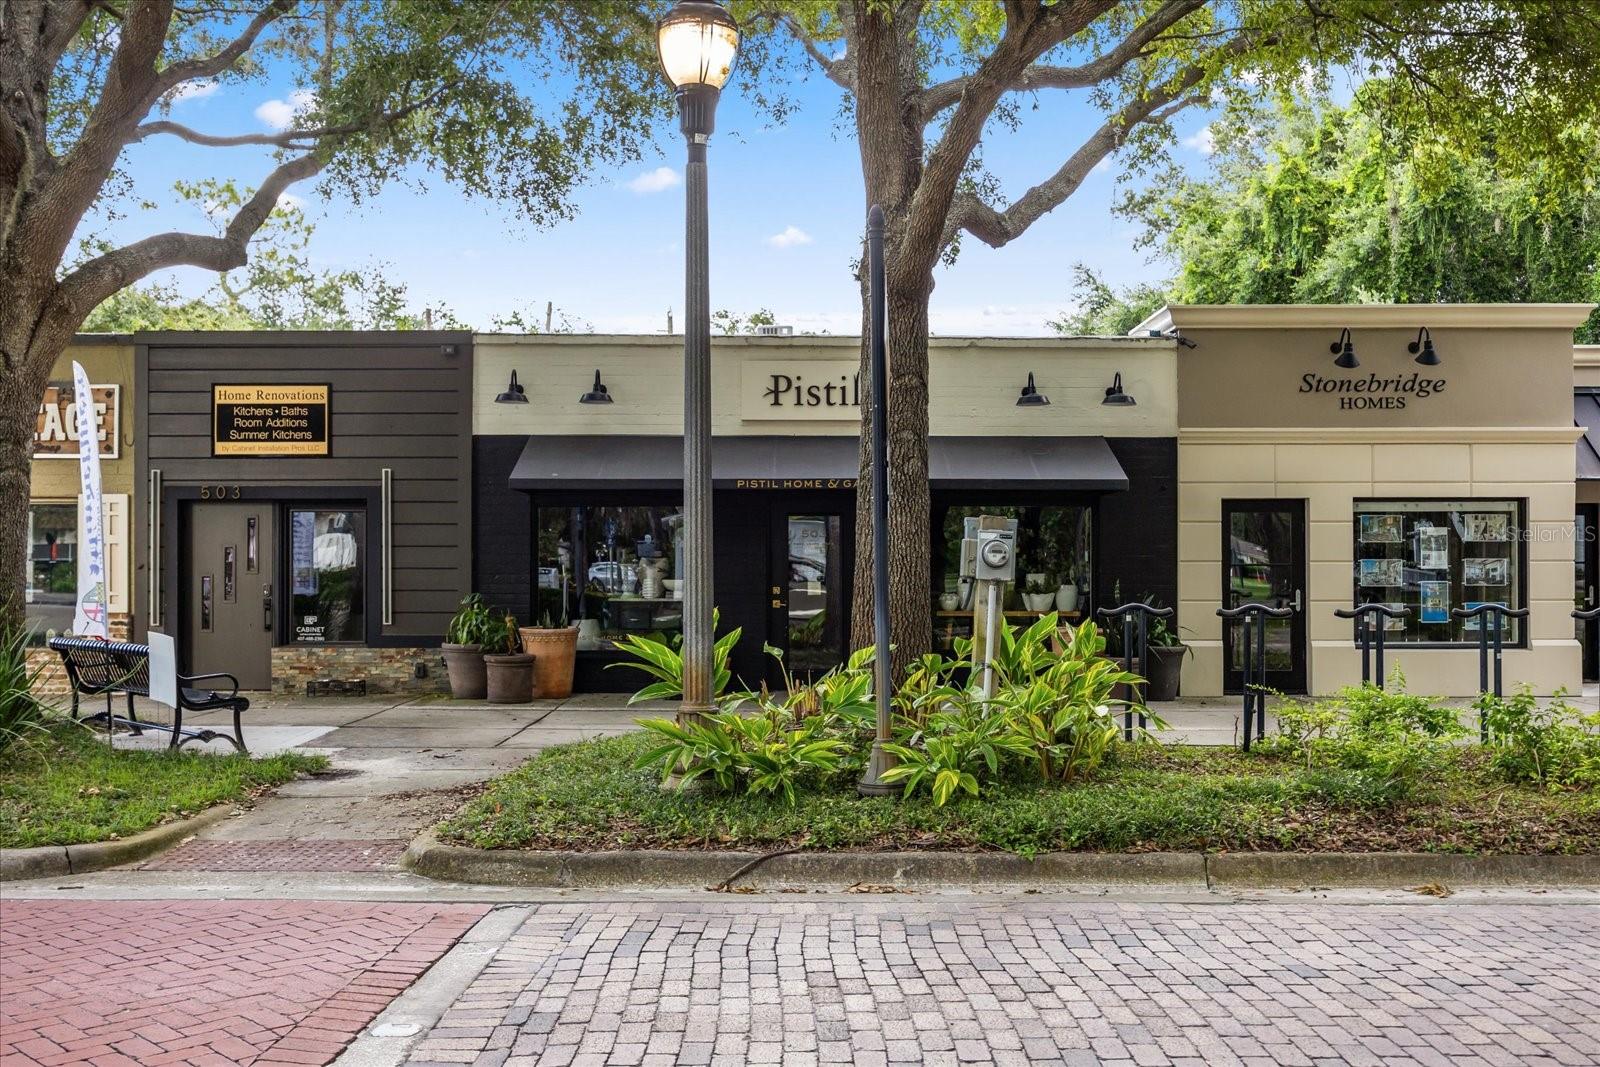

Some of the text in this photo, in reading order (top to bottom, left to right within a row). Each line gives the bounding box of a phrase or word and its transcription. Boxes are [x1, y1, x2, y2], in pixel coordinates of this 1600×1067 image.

[763, 372, 860, 406] Pistil
[1299, 373, 1446, 397] Stonebridge
[218, 390, 325, 400] Home Renovations
[1340, 397, 1406, 409] HOMES
[233, 406, 308, 416] Kitchens Baths
[35, 403, 107, 440] AGE
[234, 418, 308, 427] Room Additions
[229, 430, 312, 439] Summer Kitchens
[221, 444, 230, 452] by
[737, 480, 778, 488] PISTIL
[784, 480, 822, 488] HOME
[828, 479, 839, 488] &
[201, 485, 240, 499] 503
